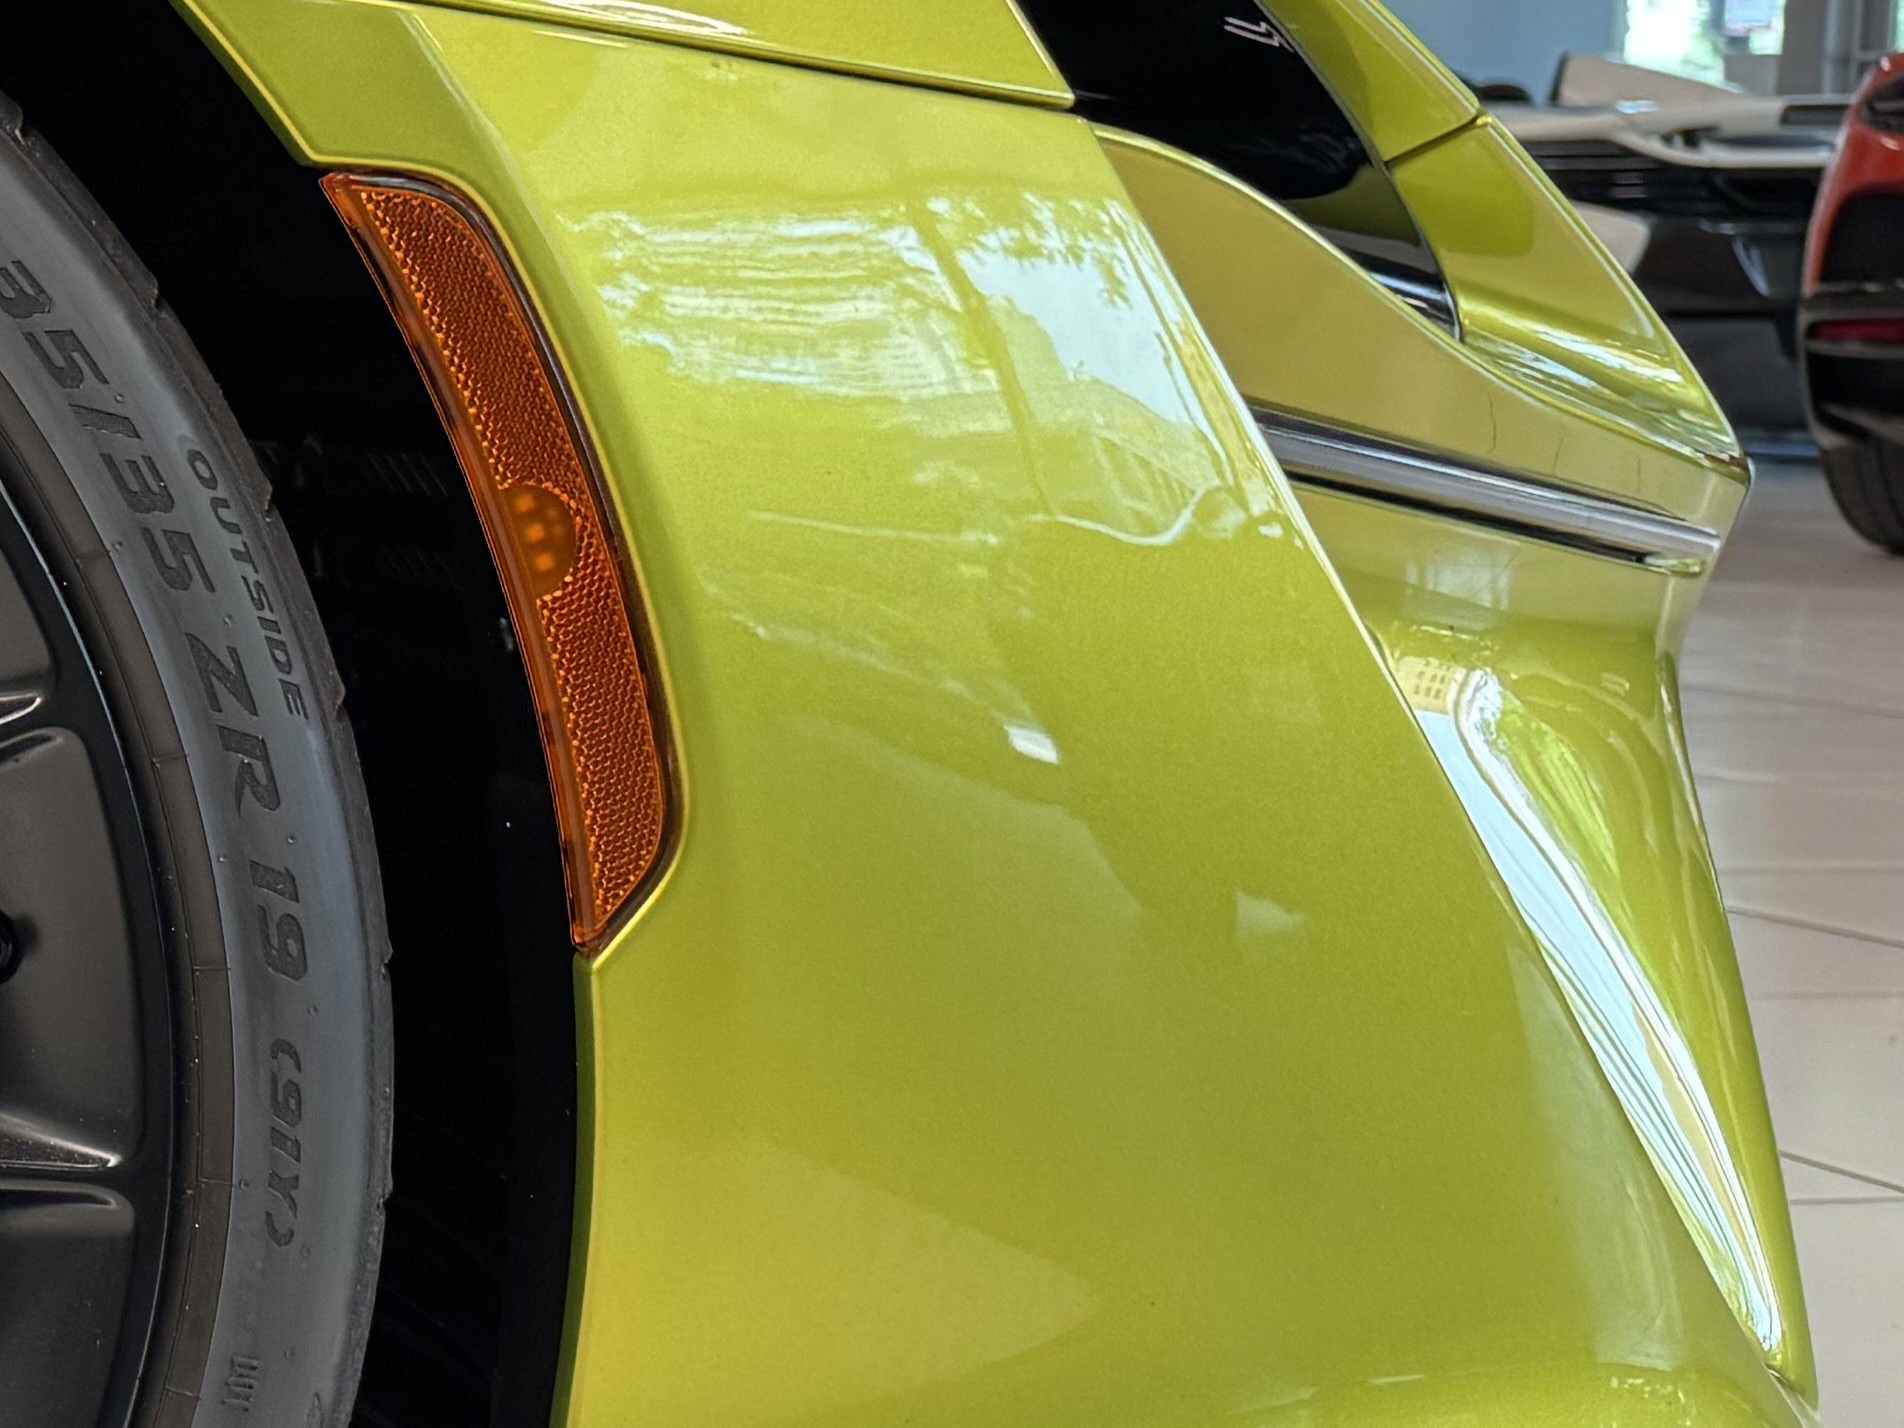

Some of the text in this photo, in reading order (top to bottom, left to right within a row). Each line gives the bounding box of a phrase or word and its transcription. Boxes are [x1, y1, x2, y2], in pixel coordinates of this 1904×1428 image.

[186, 447, 311, 722] OUTSIDE
[249, 860, 309, 985] 19
[263, 1038, 306, 1248] (91Y)
